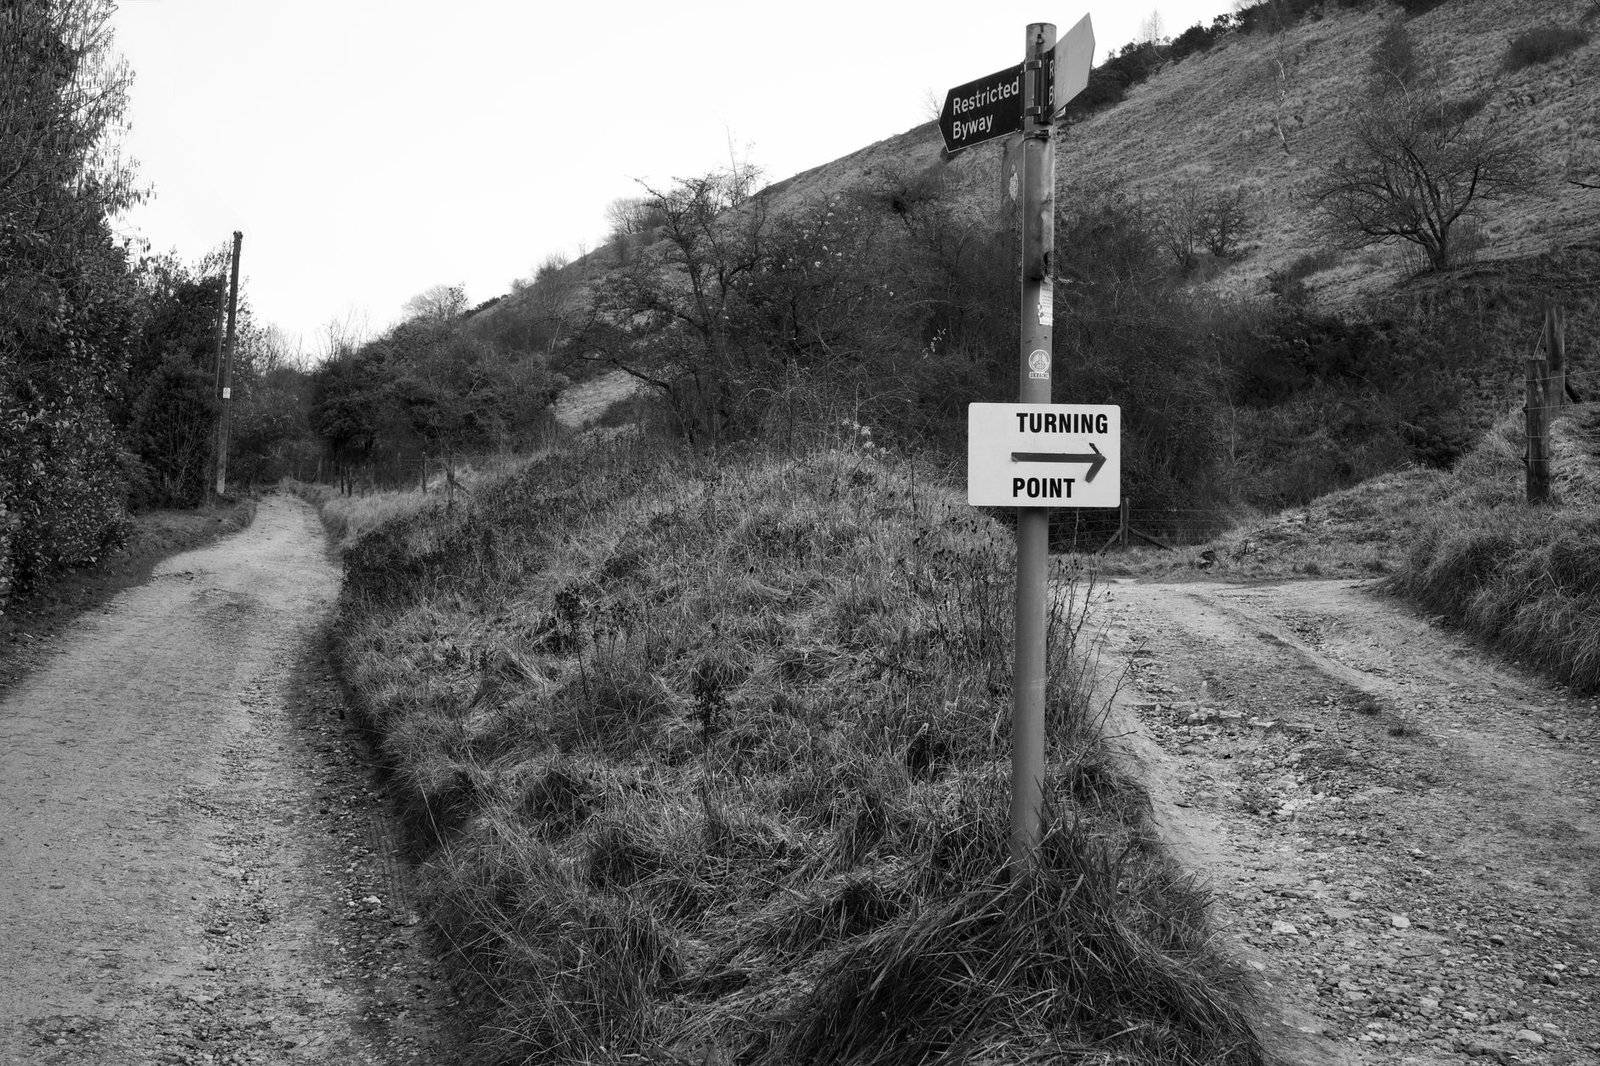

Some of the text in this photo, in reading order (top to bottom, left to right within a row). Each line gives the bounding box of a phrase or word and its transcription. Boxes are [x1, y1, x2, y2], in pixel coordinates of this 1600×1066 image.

[953, 76, 1019, 116] Restricted
[953, 114, 994, 141] Byway
[1016, 412, 1108, 434] TURNING
[1013, 477, 1076, 499] POINT
